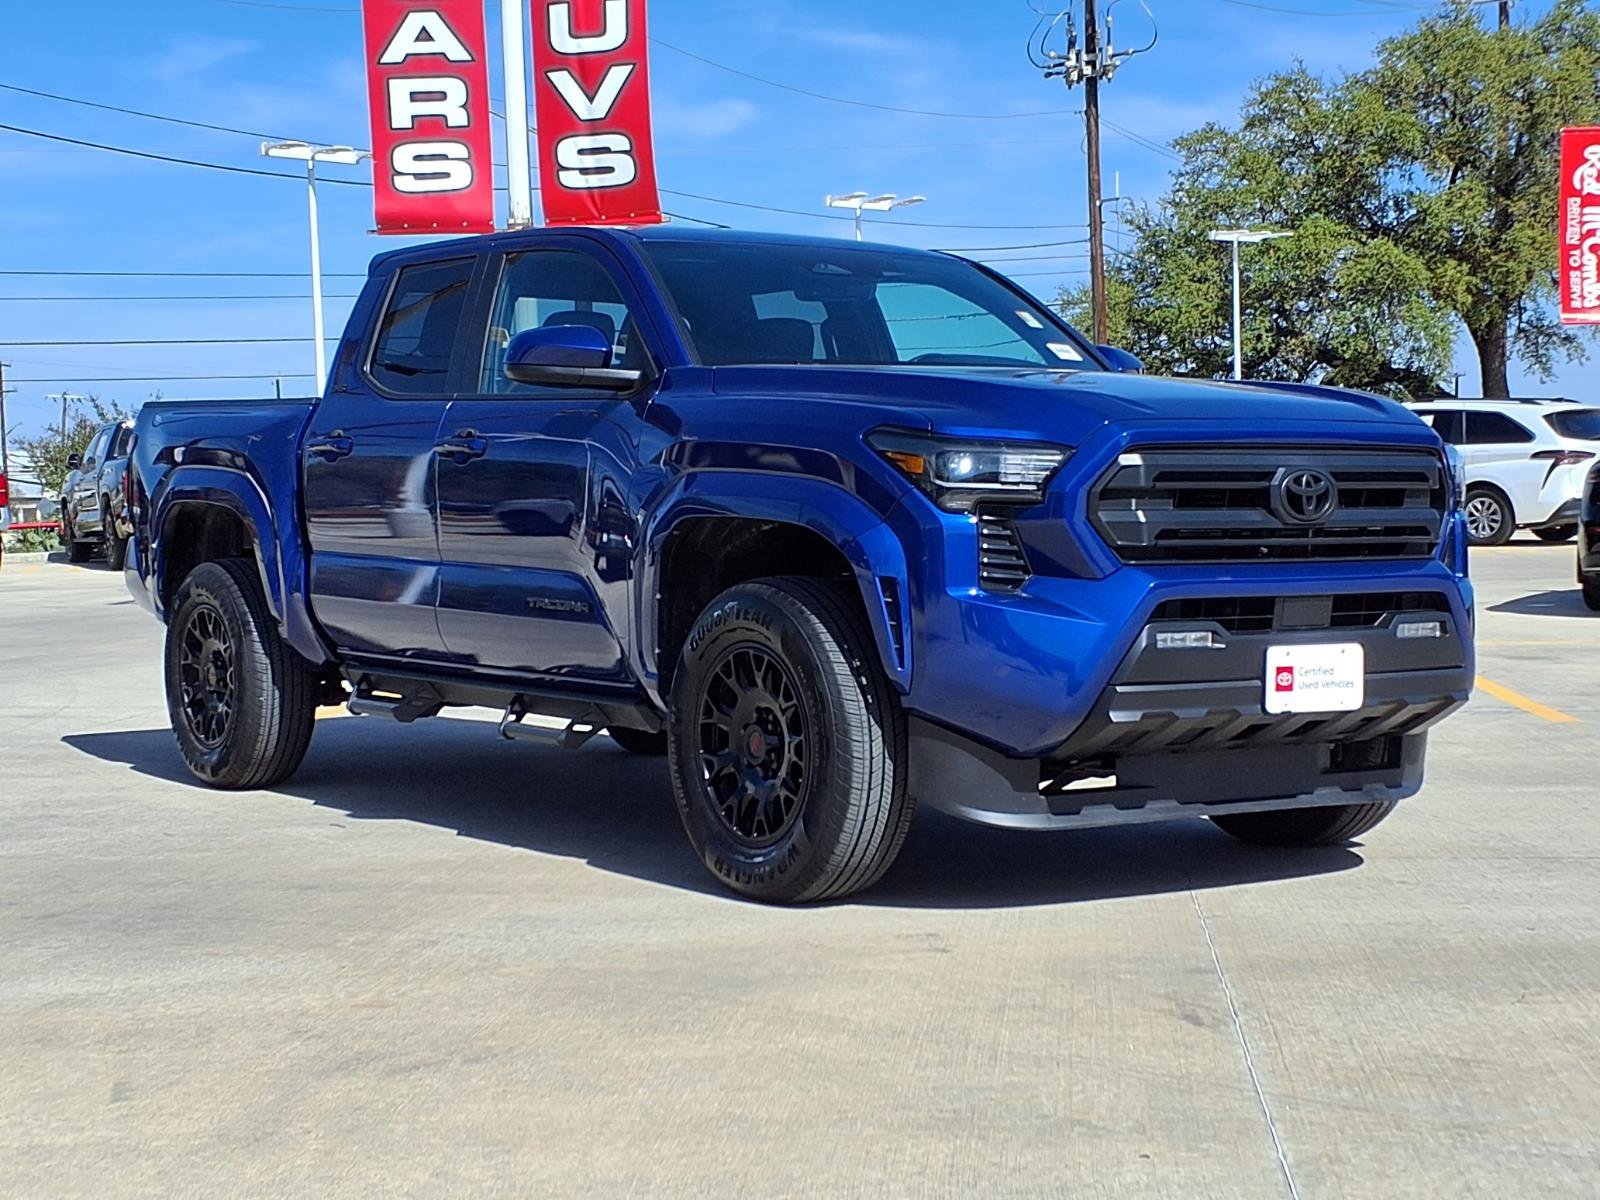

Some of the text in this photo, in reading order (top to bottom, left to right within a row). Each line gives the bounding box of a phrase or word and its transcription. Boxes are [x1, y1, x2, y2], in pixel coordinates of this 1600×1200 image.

[1568, 197, 1582, 308] DRIVEN TO SERVE
[526, 597, 590, 613] TACOMA
[689, 601, 772, 652] GOODYEAR
[1298, 666, 1335, 677] Certified
[1298, 680, 1355, 690] Used Vehicles
